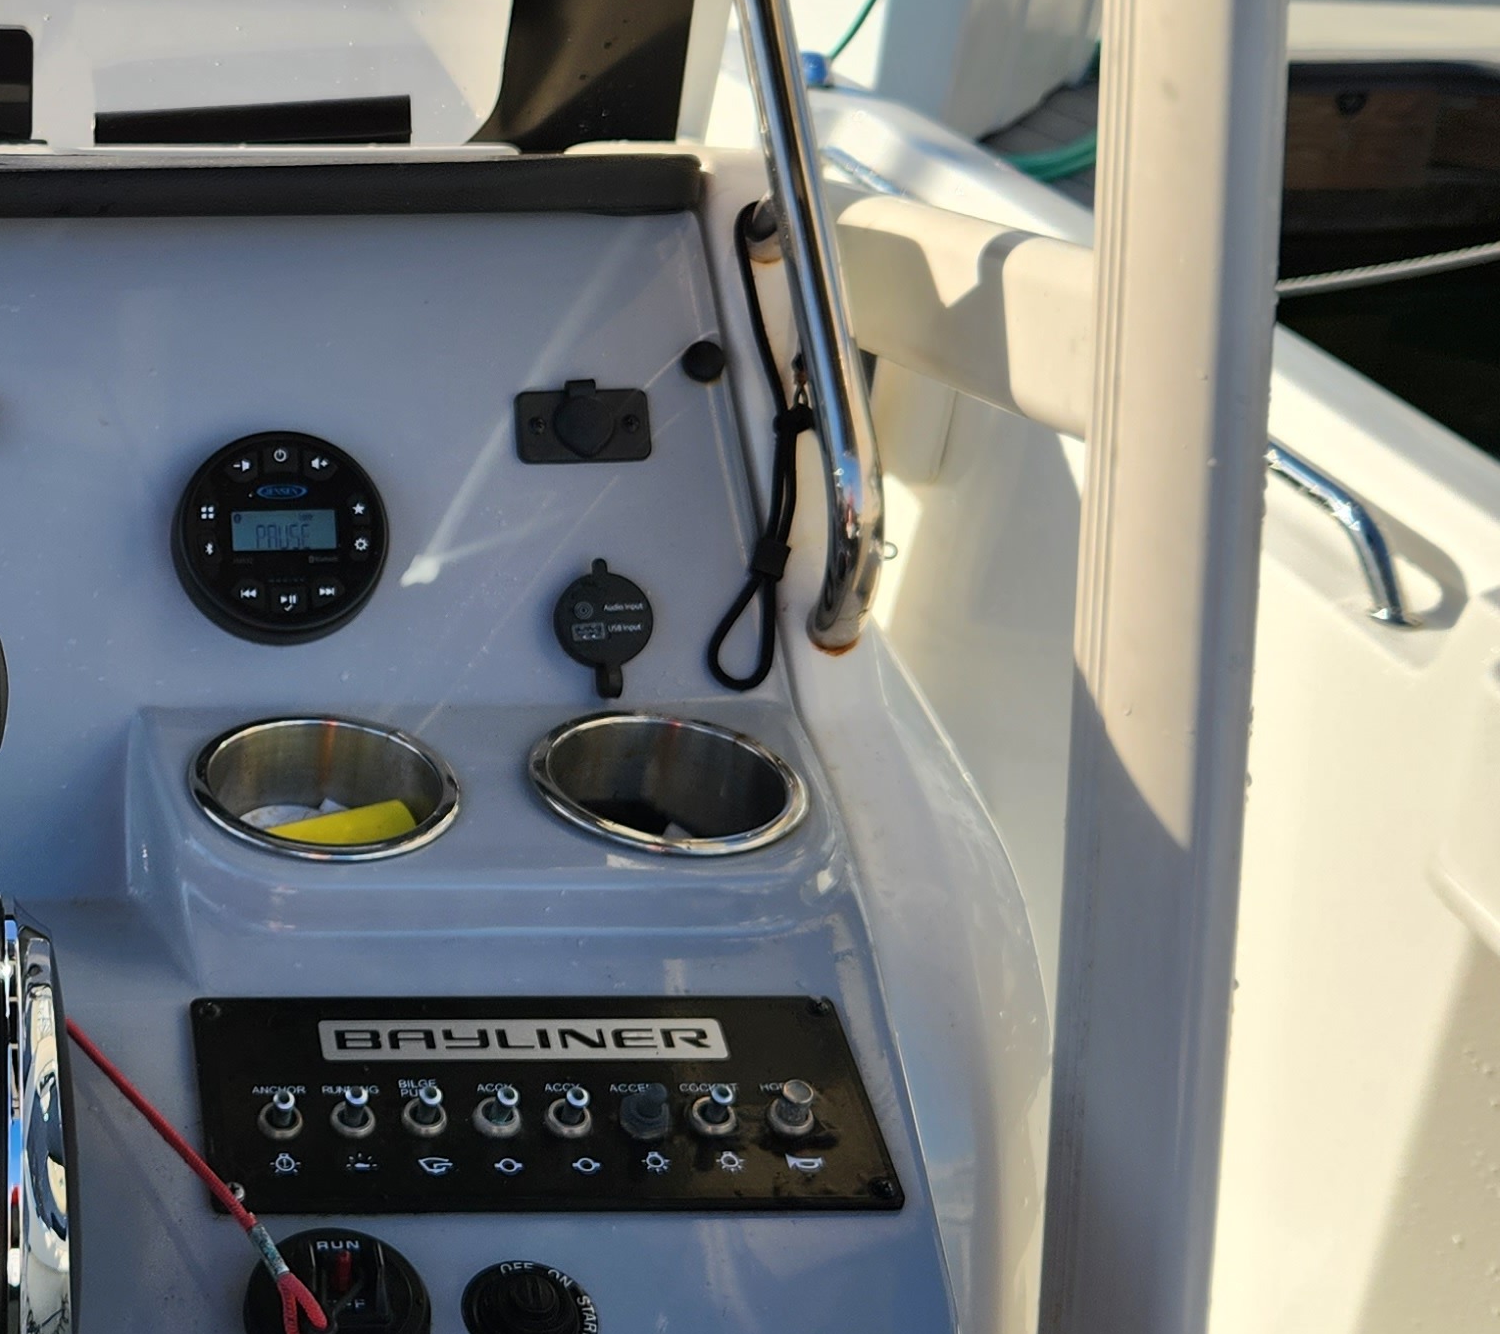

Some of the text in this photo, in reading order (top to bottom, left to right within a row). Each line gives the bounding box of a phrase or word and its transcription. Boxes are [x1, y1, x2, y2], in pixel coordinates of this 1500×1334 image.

[255, 524, 311, 550] PAUSE
[608, 623, 622, 632] USB
[332, 1027, 714, 1051] BAYLINER
[398, 1079, 436, 1089] BILGE
[609, 1083, 650, 1093] ACCE
[252, 1085, 306, 1094] ANCHOR
[321, 1085, 379, 1095] RUNNG
[316, 1240, 360, 1250] RUN
[500, 1261, 534, 1275] OFF
[548, 1268, 573, 1288] ON
